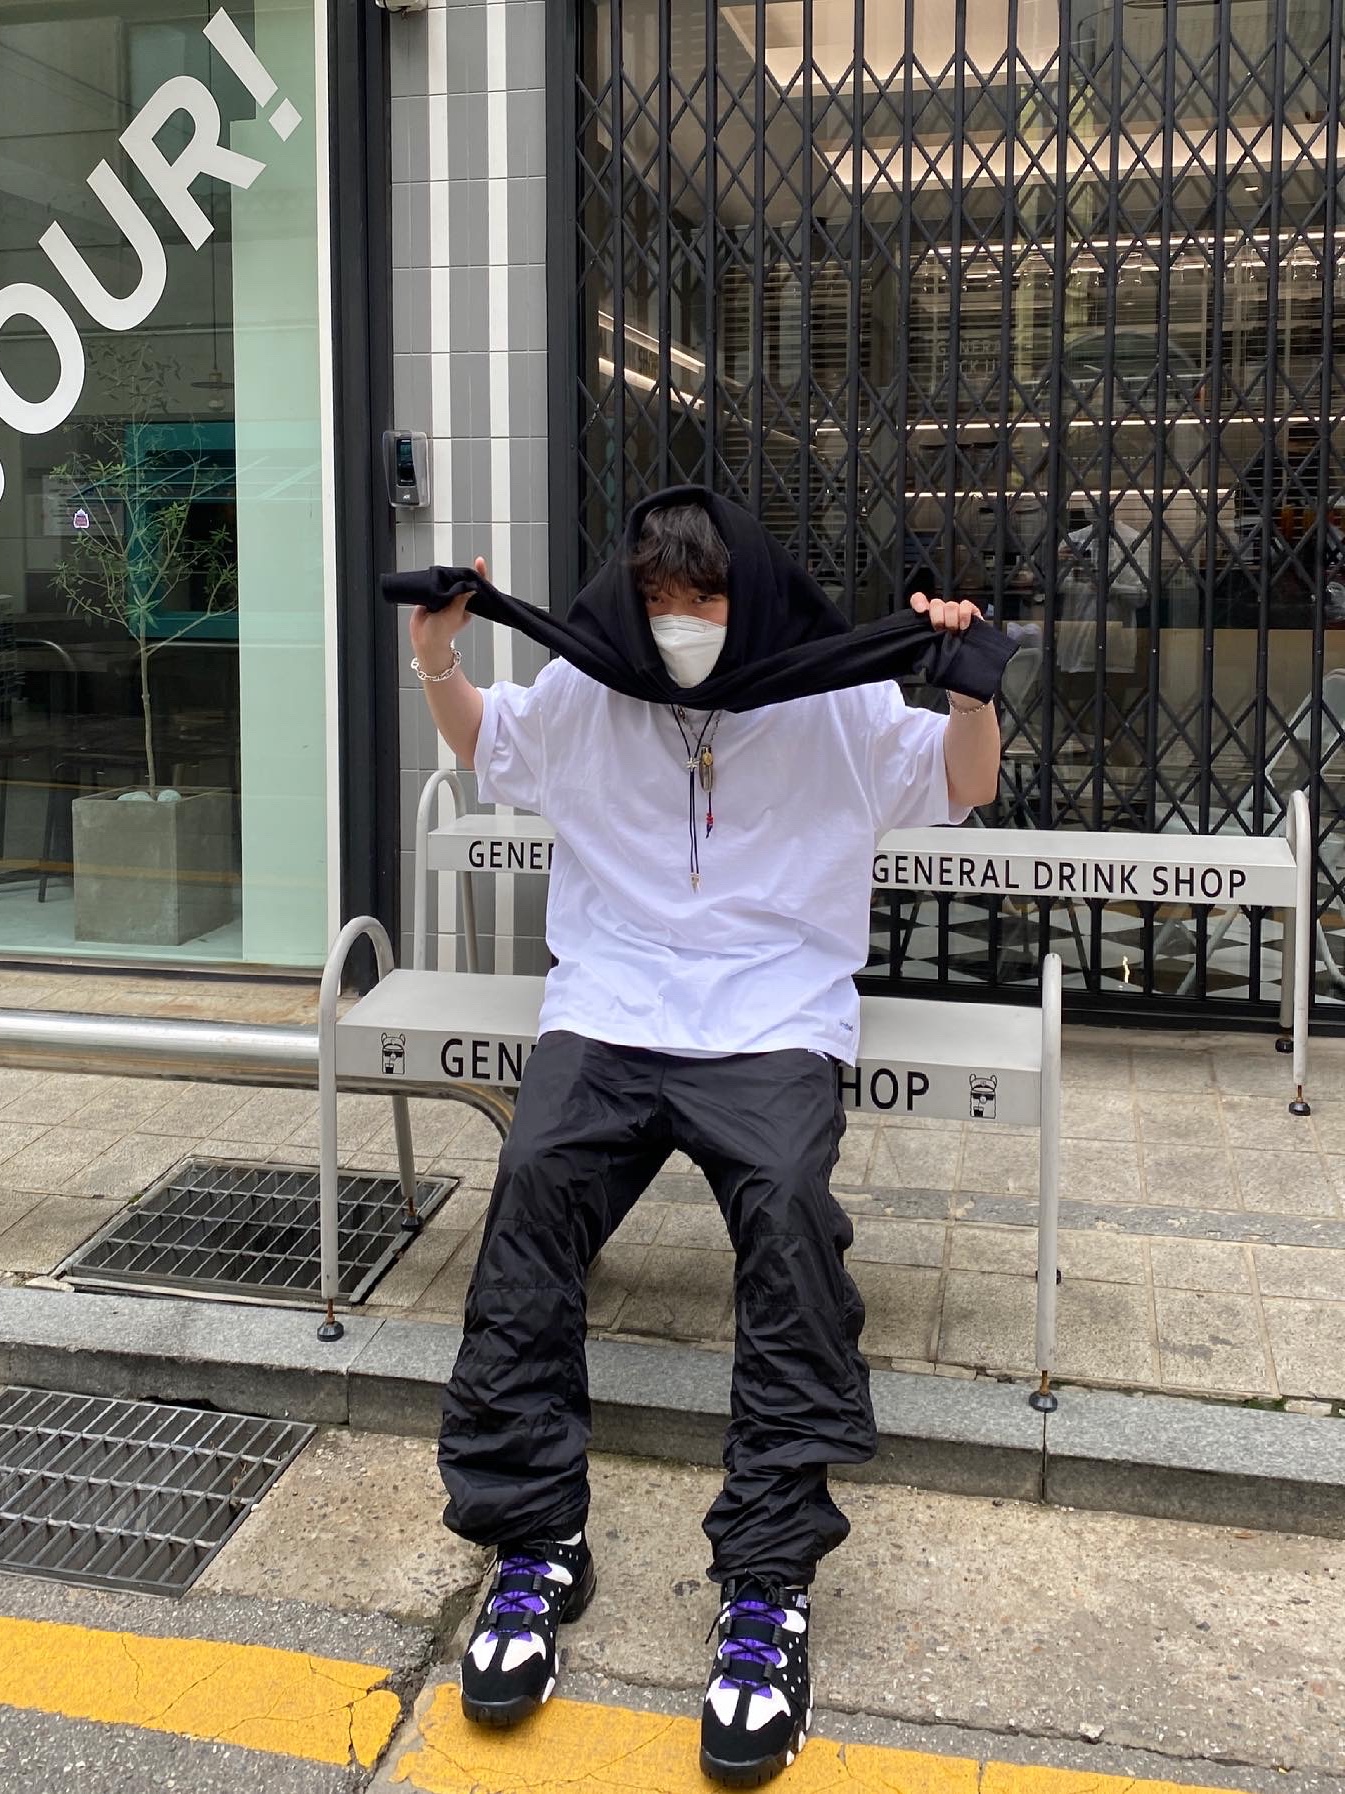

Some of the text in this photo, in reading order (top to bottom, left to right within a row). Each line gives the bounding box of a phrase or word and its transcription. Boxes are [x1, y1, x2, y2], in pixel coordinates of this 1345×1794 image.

[0, 6, 302, 500] OUR!
[872, 854, 1019, 889] GENERAL
[1034, 860, 1138, 895] DRINK
[1152, 866, 1247, 898] SHOP
[440, 1038, 930, 1111] GEN HOP
